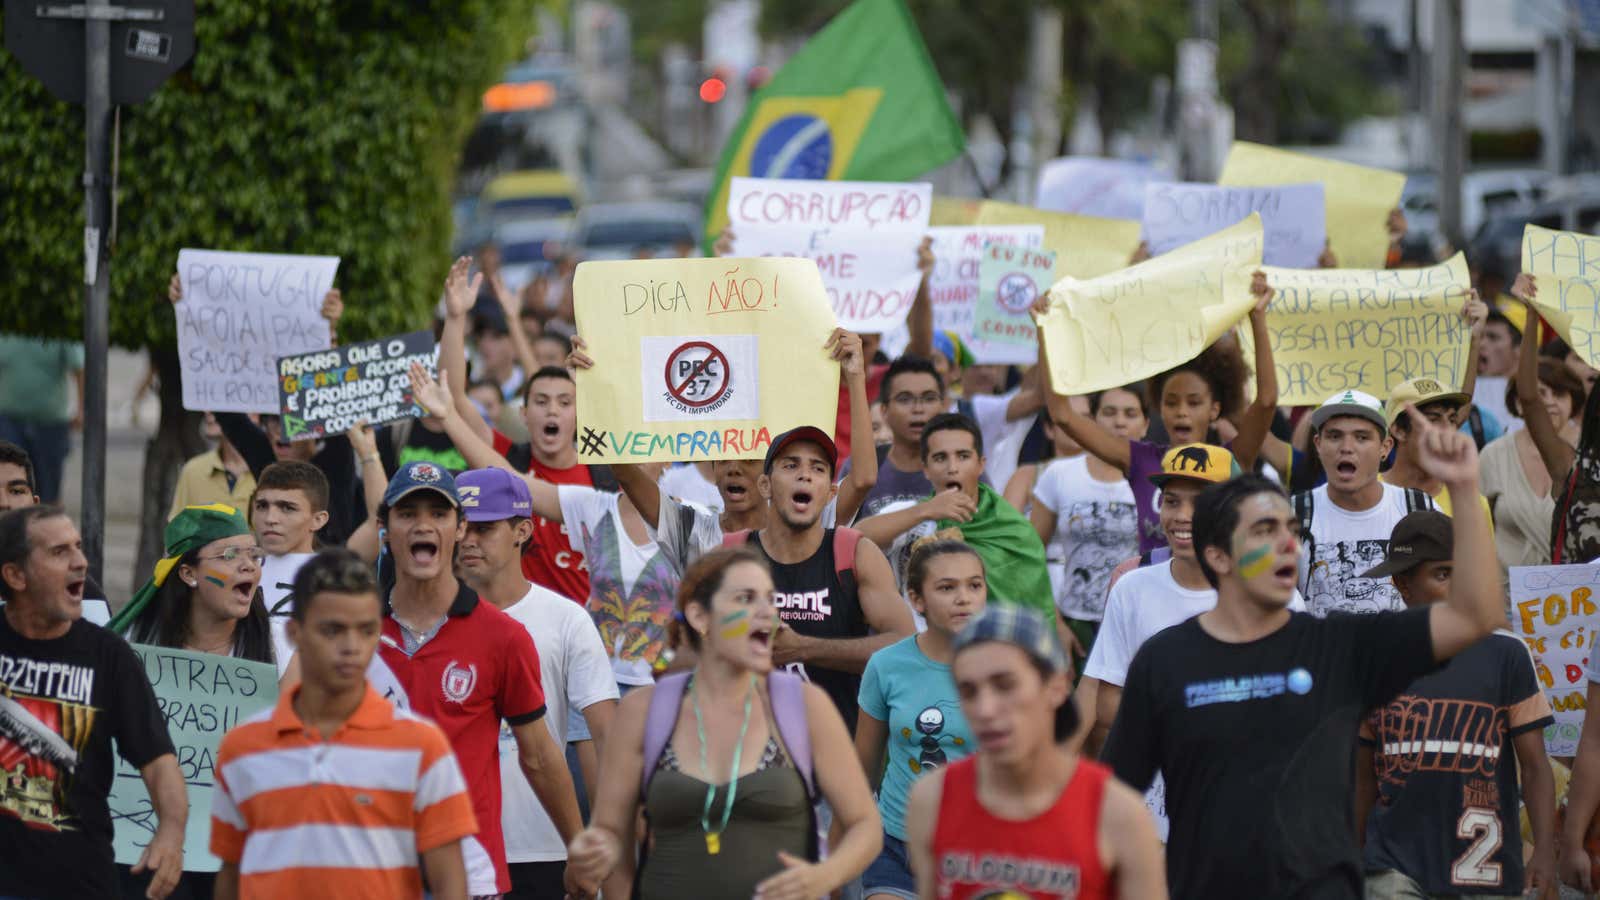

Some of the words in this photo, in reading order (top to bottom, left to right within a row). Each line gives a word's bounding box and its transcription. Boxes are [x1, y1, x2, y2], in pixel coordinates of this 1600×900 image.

[740, 189, 922, 228] CORRUPÇÃO
[280, 352, 341, 377] AGORA
[348, 343, 382, 365] QUE
[387, 339, 405, 357] O
[678, 359, 717, 377] PEC
[283, 366, 359, 394] GIGANTE
[304, 378, 385, 409] PROIBIDO
[685, 379, 711, 396] 37
[688, 387, 734, 415] IMPUNIDADE
[579, 425, 772, 458] #VEMPRARUA
[780, 610, 825, 621] REVOLUTION
[1451, 806, 1504, 886] 2
